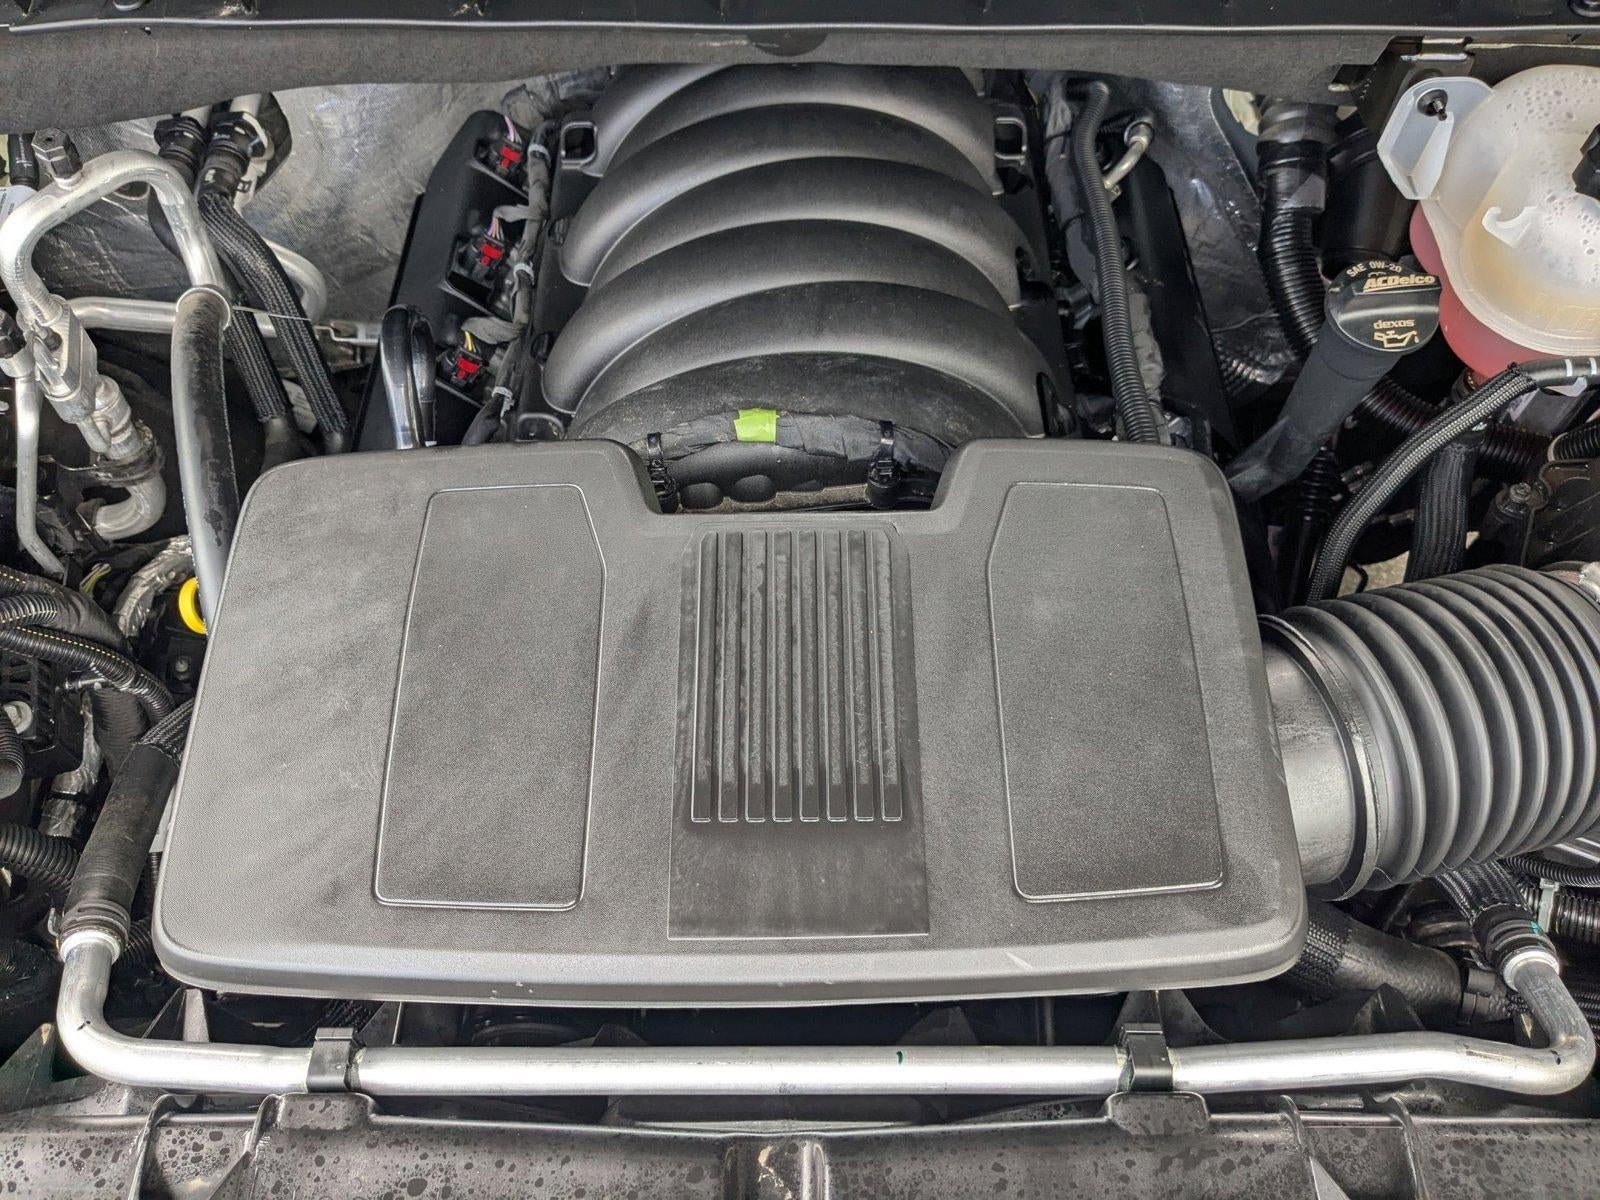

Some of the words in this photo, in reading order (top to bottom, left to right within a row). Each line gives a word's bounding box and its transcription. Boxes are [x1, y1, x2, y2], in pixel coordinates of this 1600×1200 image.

[1346, 263, 1366, 277] SAE
[1369, 261, 1402, 272] 0W-20
[1363, 274, 1435, 290] ACDelco
[1373, 320, 1414, 329] dexos
